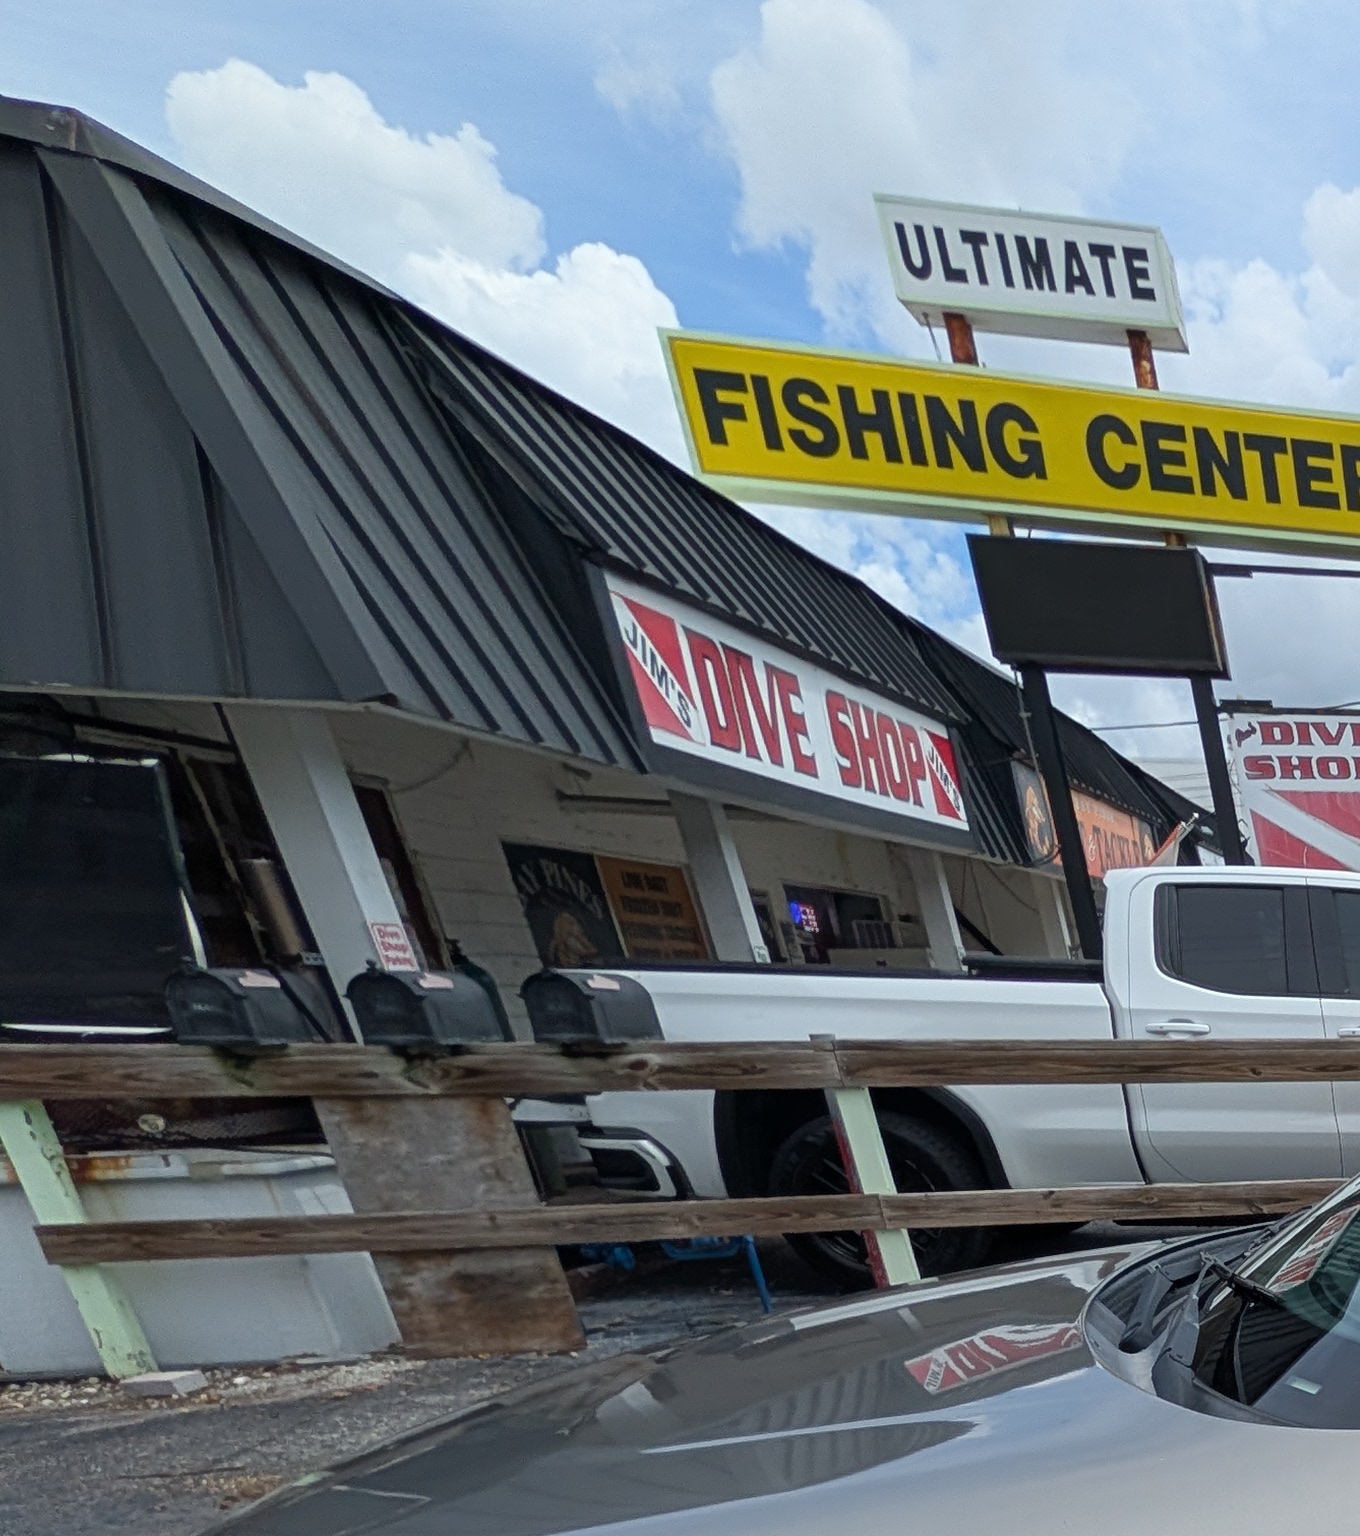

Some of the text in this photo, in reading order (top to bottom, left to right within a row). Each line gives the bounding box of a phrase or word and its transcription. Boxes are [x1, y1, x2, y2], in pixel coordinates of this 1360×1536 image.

[894, 221, 1157, 302] ULTIMATE
[692, 366, 1049, 481] FISHING
[624, 621, 693, 729] JIM'S
[680, 624, 819, 780] DIVE
[825, 688, 930, 808] SHOP
